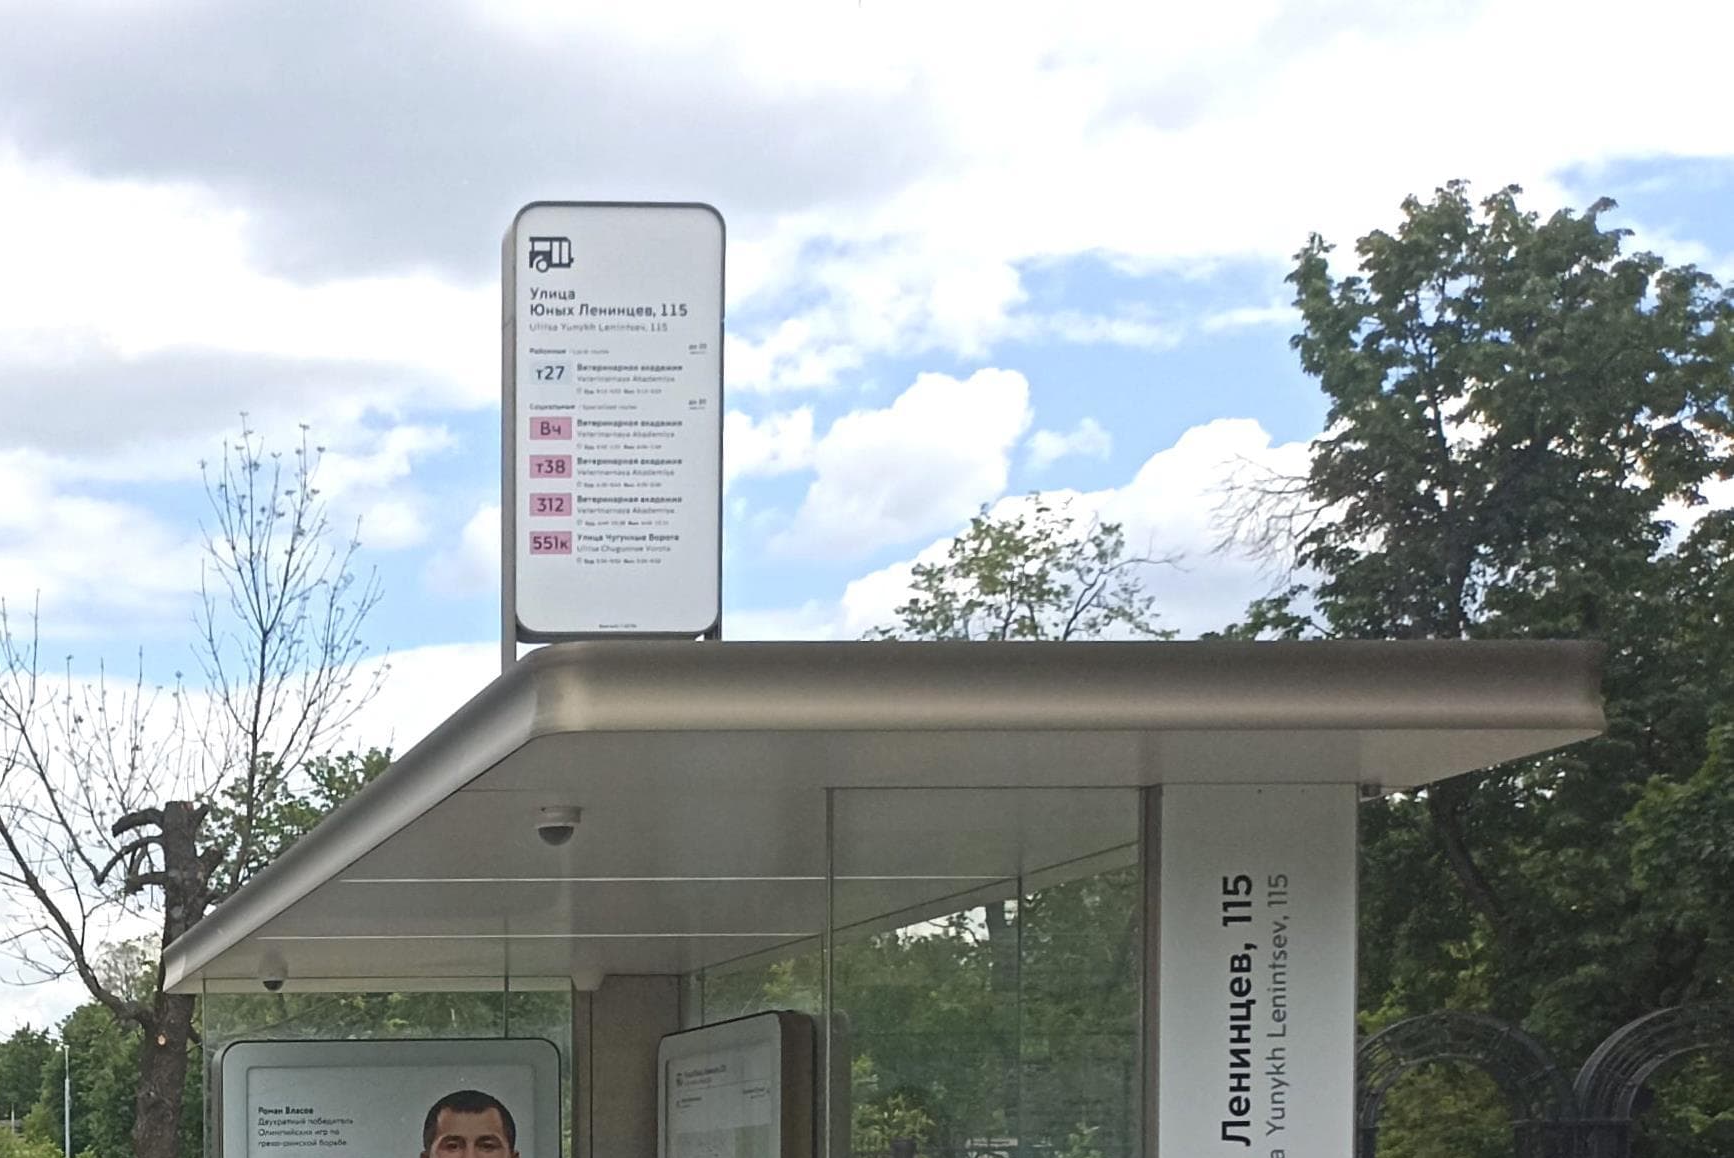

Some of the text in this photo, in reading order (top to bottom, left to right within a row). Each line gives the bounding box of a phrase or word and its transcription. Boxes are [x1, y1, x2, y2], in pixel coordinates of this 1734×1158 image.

[529, 286, 576, 302] Улица
[529, 303, 688, 319] Юных Ленинцев, 115
[650, 322, 668, 332] 115
[537, 497, 565, 513] 312
[532, 535, 569, 551] 551к
[1222, 873, 1253, 928] 115
[1266, 872, 1289, 908] 115
[1265, 914, 1291, 1038] Lenintsev,
[1221, 941, 1258, 1148] Ленинцев,
[1264, 1047, 1291, 1137] Yunykh
